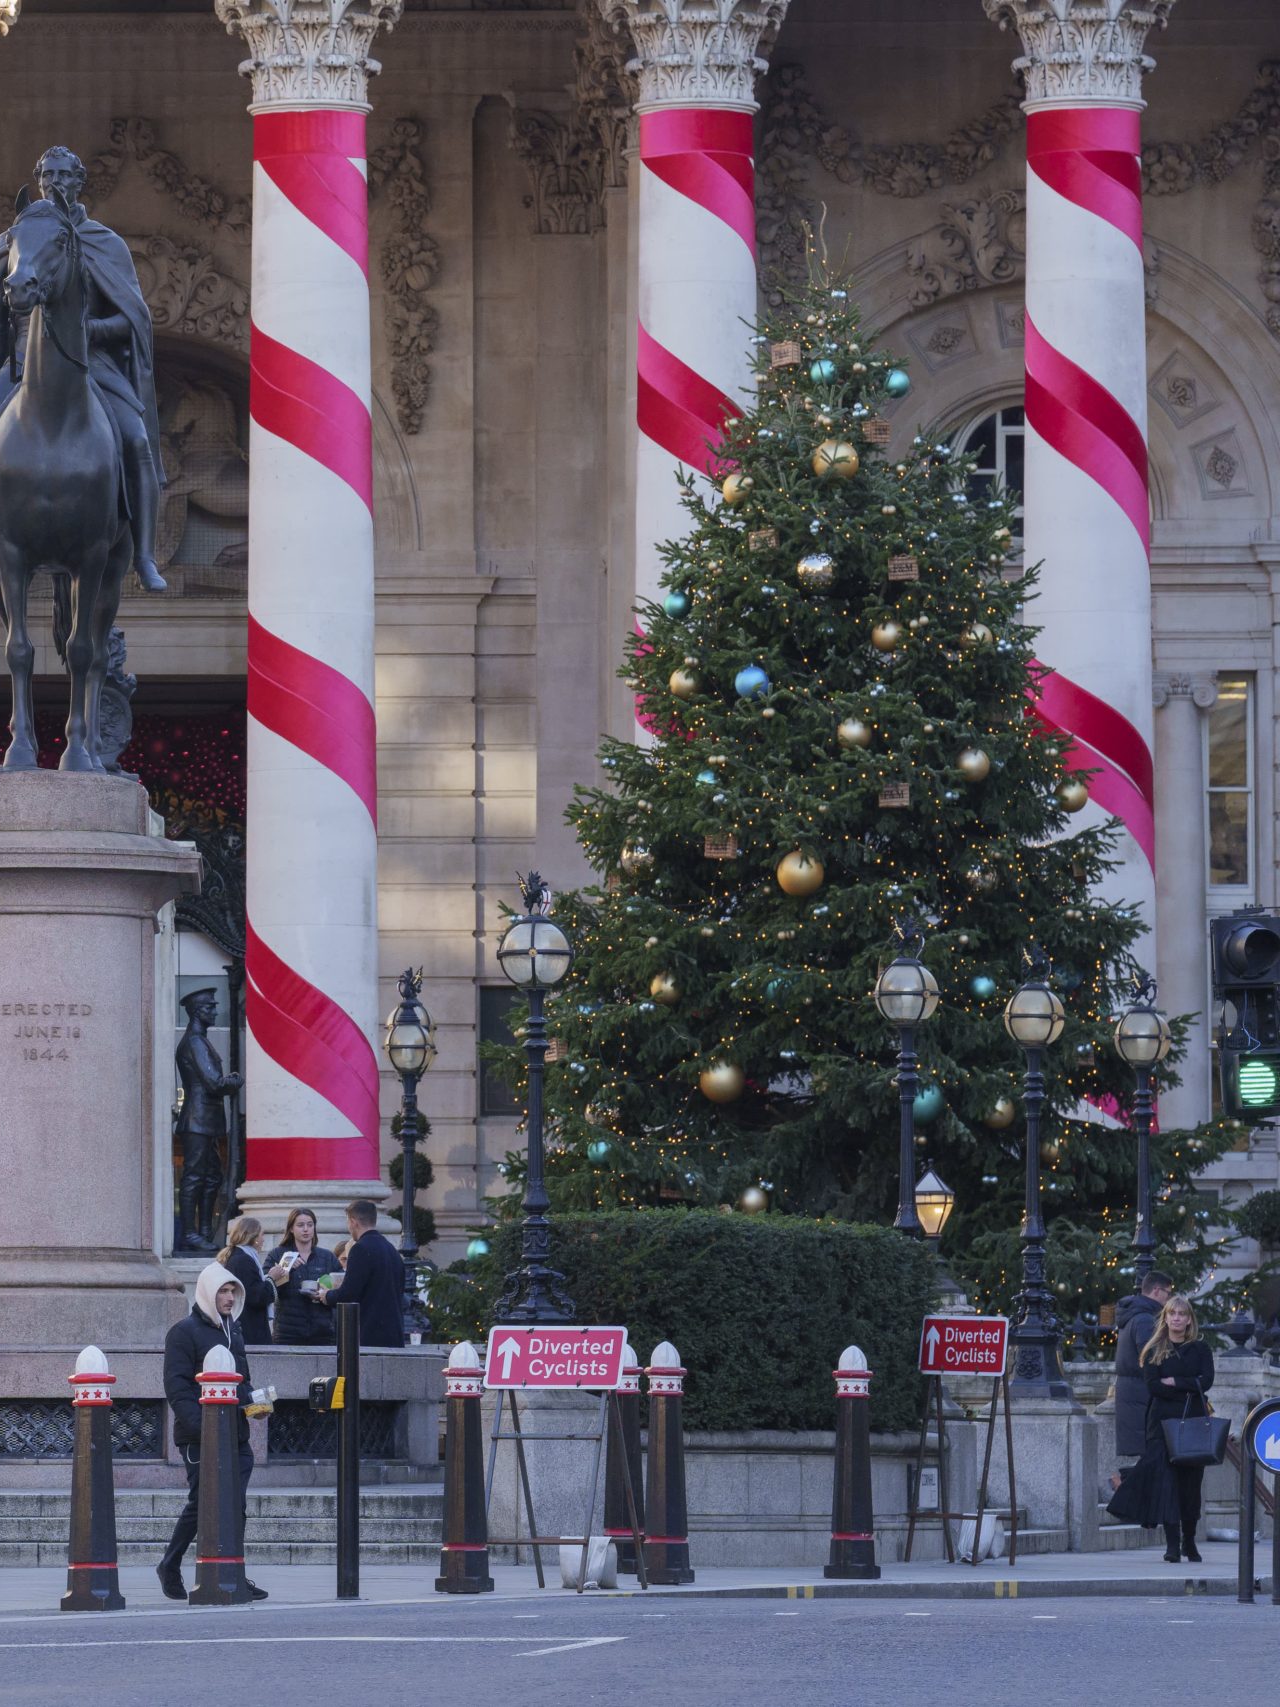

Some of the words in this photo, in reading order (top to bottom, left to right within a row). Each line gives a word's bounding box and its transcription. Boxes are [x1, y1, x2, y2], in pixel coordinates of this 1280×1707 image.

[1, 1003, 93, 1017] ERECTED
[14, 1026, 62, 1039] JUNE
[65, 1026, 81, 1039] 18
[23, 1048, 69, 1061] 1844
[945, 1327, 1001, 1344] Diverted
[528, 1338, 615, 1355] Diverted
[945, 1346, 997, 1366] Cyclists
[528, 1359, 609, 1379] Cyclists
